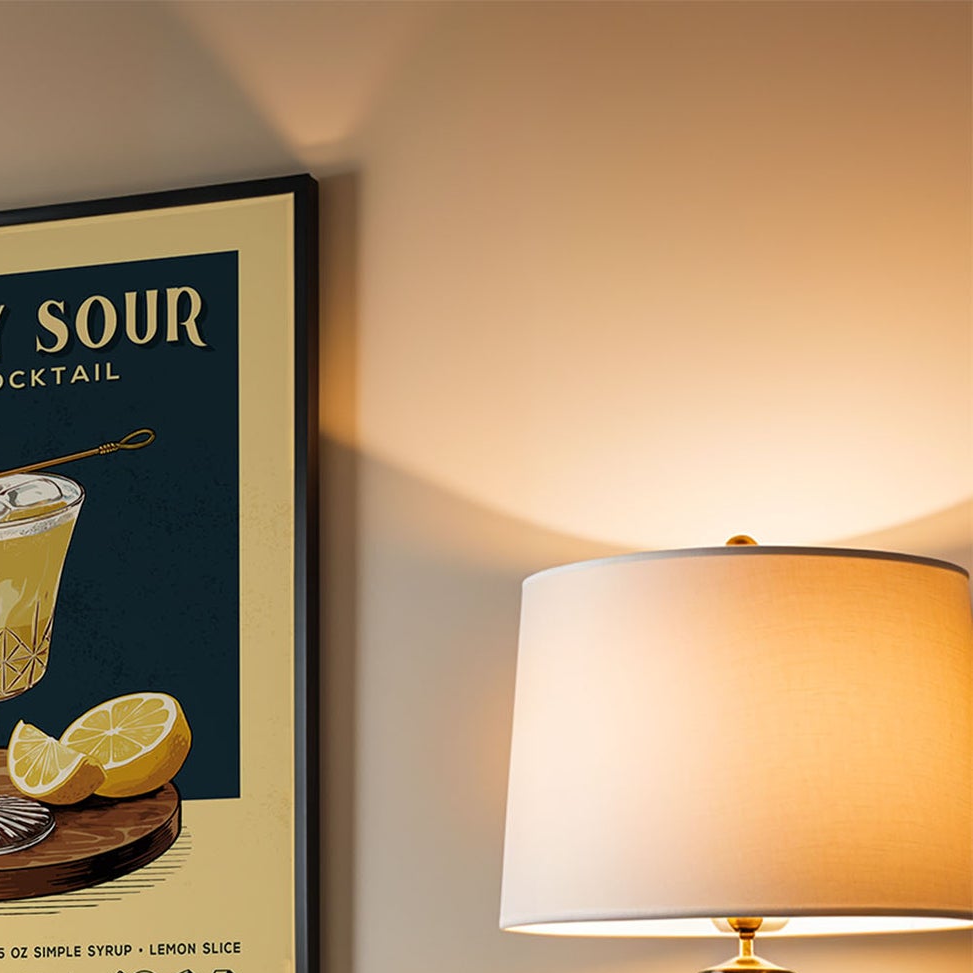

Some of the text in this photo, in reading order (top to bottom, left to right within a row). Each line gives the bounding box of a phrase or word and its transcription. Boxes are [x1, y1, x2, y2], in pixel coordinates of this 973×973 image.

[35, 286, 208, 354] SOUR
[10, 946, 28, 959] OZ
[33, 945, 82, 959] SIMPLE
[87, 944, 133, 958] SYRUP
[149, 942, 196, 956] LEMON
[202, 941, 241, 955] SLICE
